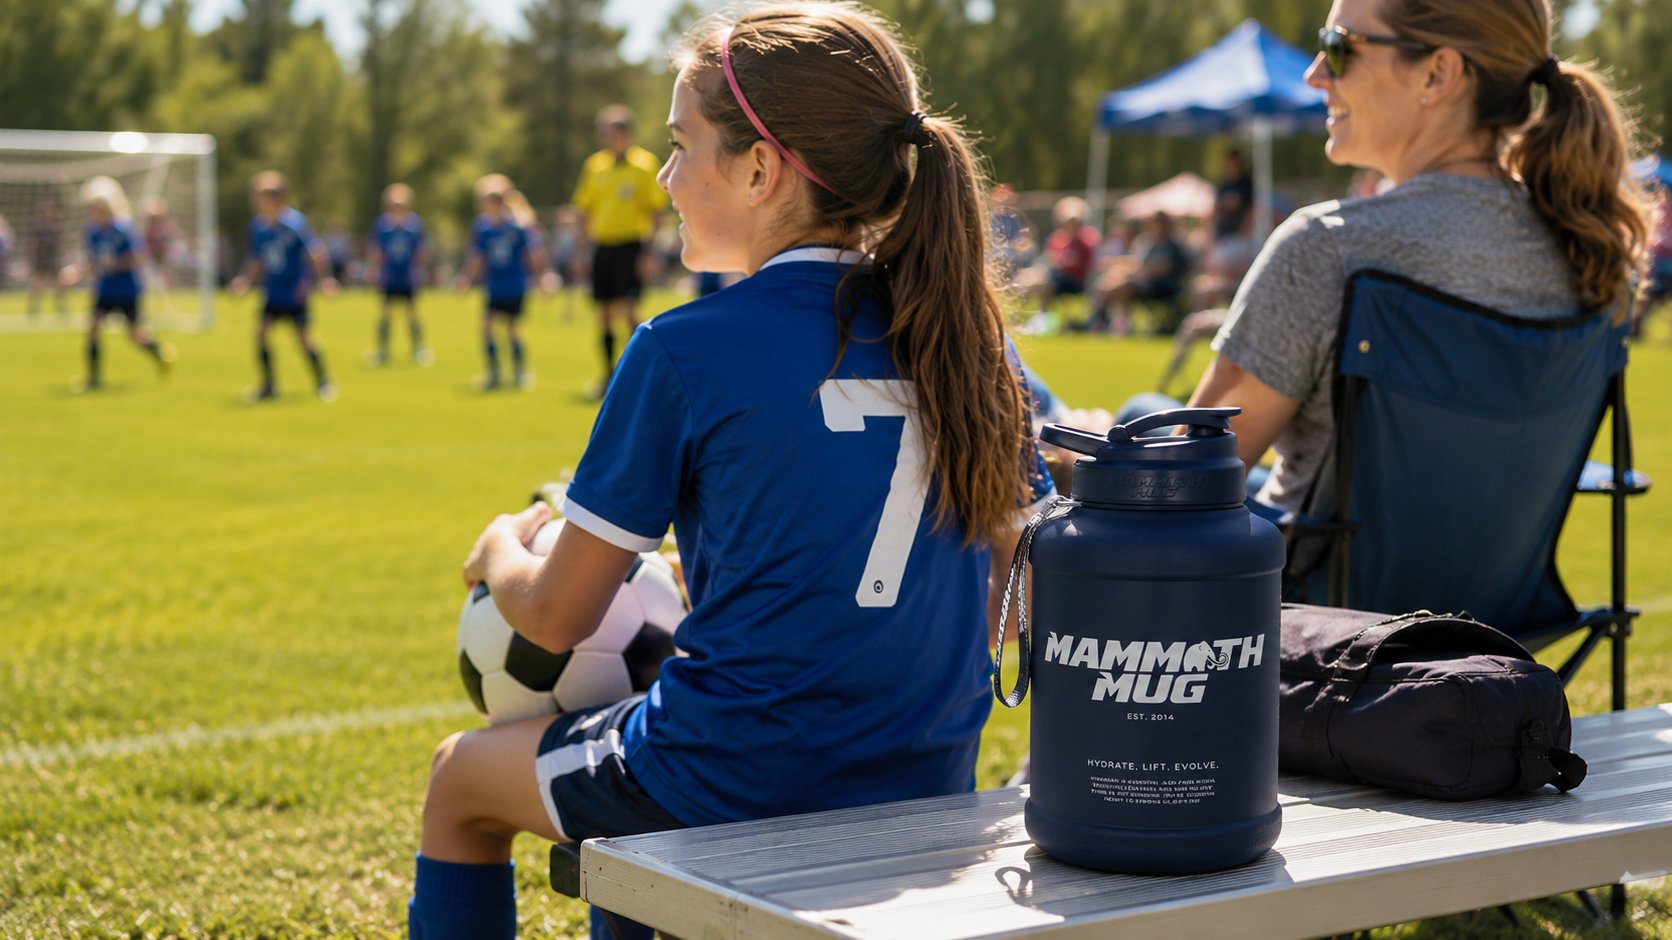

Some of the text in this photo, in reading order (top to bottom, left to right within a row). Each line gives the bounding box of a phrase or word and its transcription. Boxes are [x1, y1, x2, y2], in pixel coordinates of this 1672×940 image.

[819, 378, 935, 608] 7
[1091, 671, 1209, 704] MUG
[1126, 712, 1175, 721] EST. 2014
[1142, 762, 1170, 771] LIFT.
[1174, 760, 1219, 771] EVOLVE.
